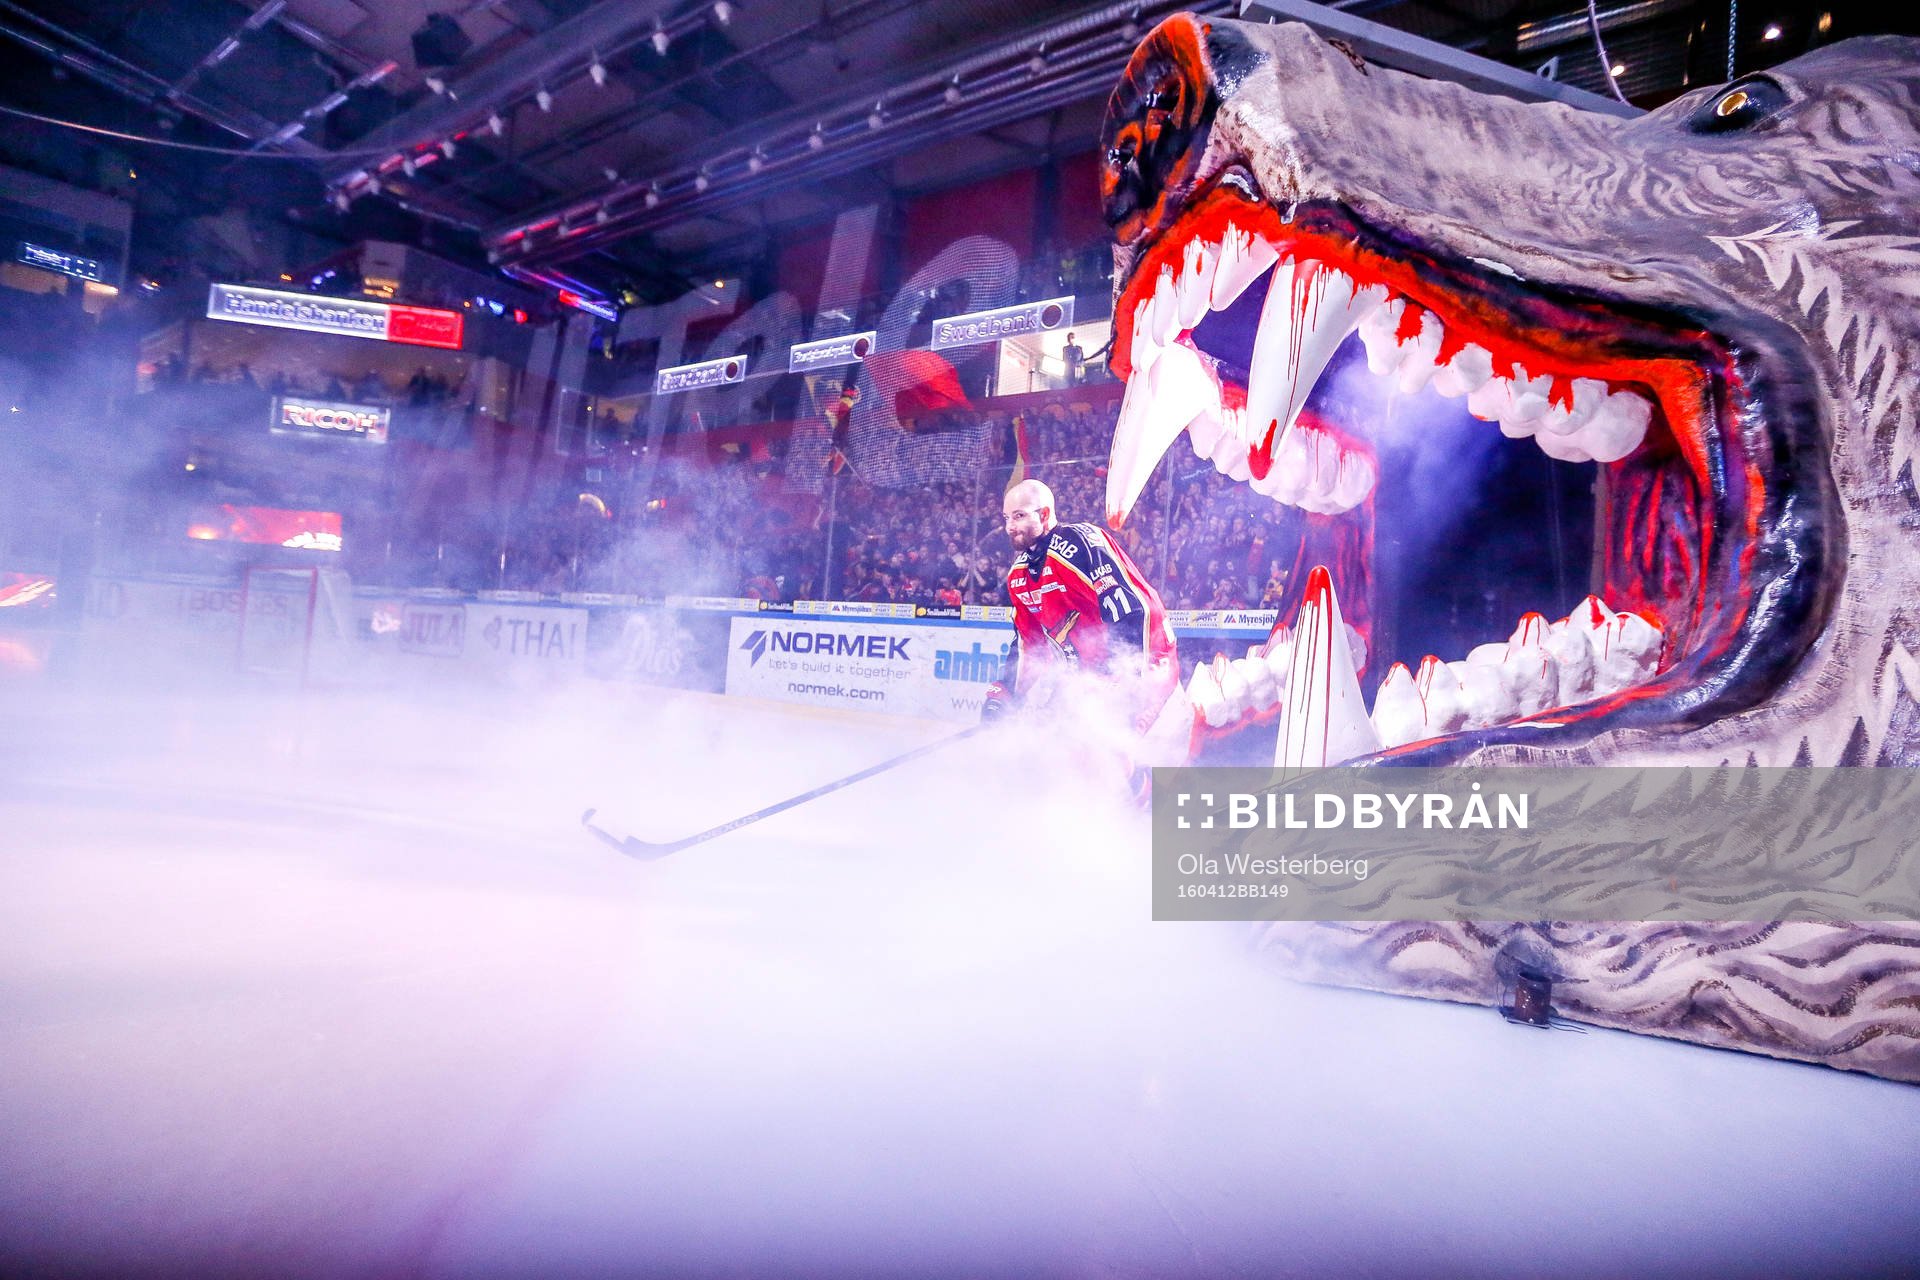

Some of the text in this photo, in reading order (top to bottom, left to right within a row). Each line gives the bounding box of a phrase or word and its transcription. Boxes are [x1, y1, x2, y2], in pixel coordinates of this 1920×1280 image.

[224, 291, 385, 332] Handelsbanken
[940, 310, 1039, 343] Swedbank
[282, 405, 378, 434] RICOH
[1090, 564, 1113, 581] LKAB
[1103, 588, 1131, 622] 11
[771, 631, 912, 661] NORMEK
[802, 659, 830, 673] build
[836, 663, 844, 674] it
[850, 664, 911, 680] together
[788, 683, 884, 701] normek.com
